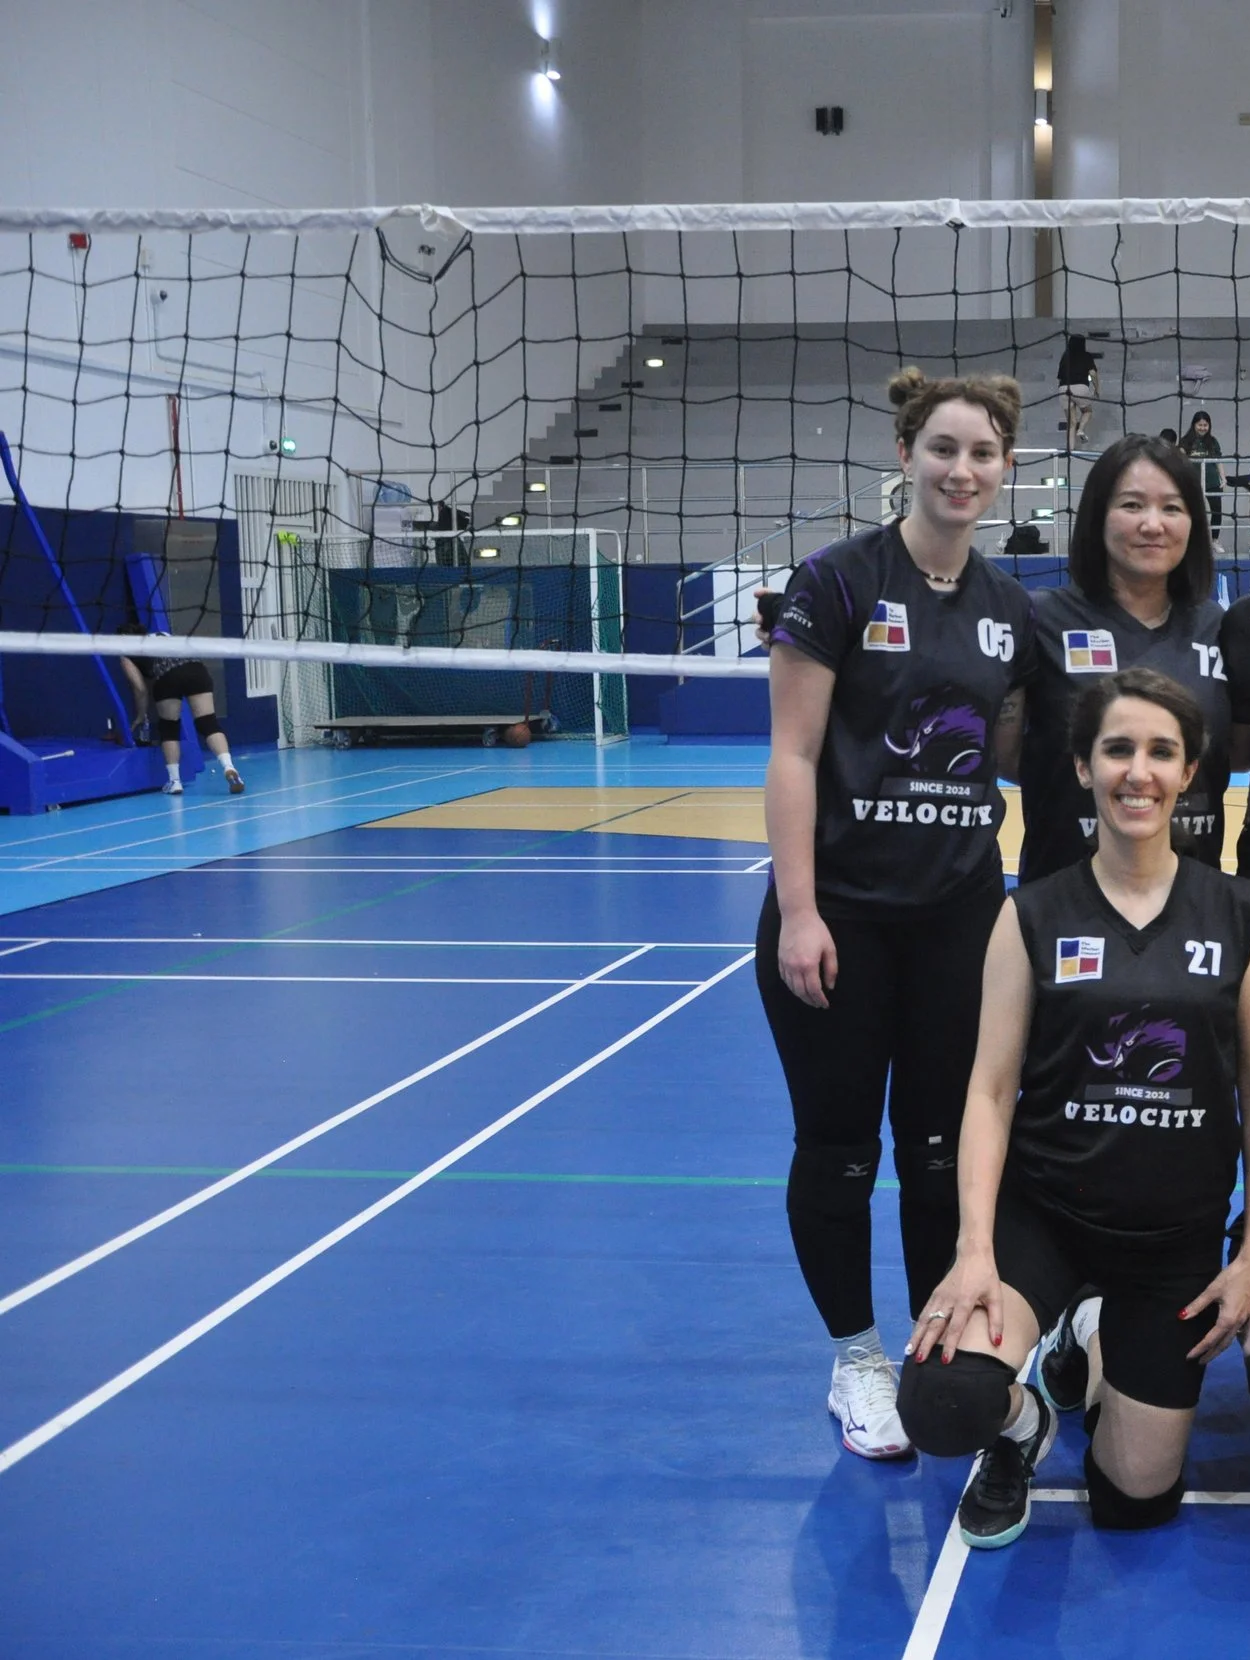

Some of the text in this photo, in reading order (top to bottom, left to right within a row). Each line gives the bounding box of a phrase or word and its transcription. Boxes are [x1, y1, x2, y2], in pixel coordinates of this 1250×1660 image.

[977, 617, 1015, 662] 05
[909, 781, 971, 796] SINCE 2024
[1184, 939, 1222, 976] 27
[1114, 1086, 1171, 1100] SINCE 2024
[1064, 1101, 1207, 1129] VELOCITY
